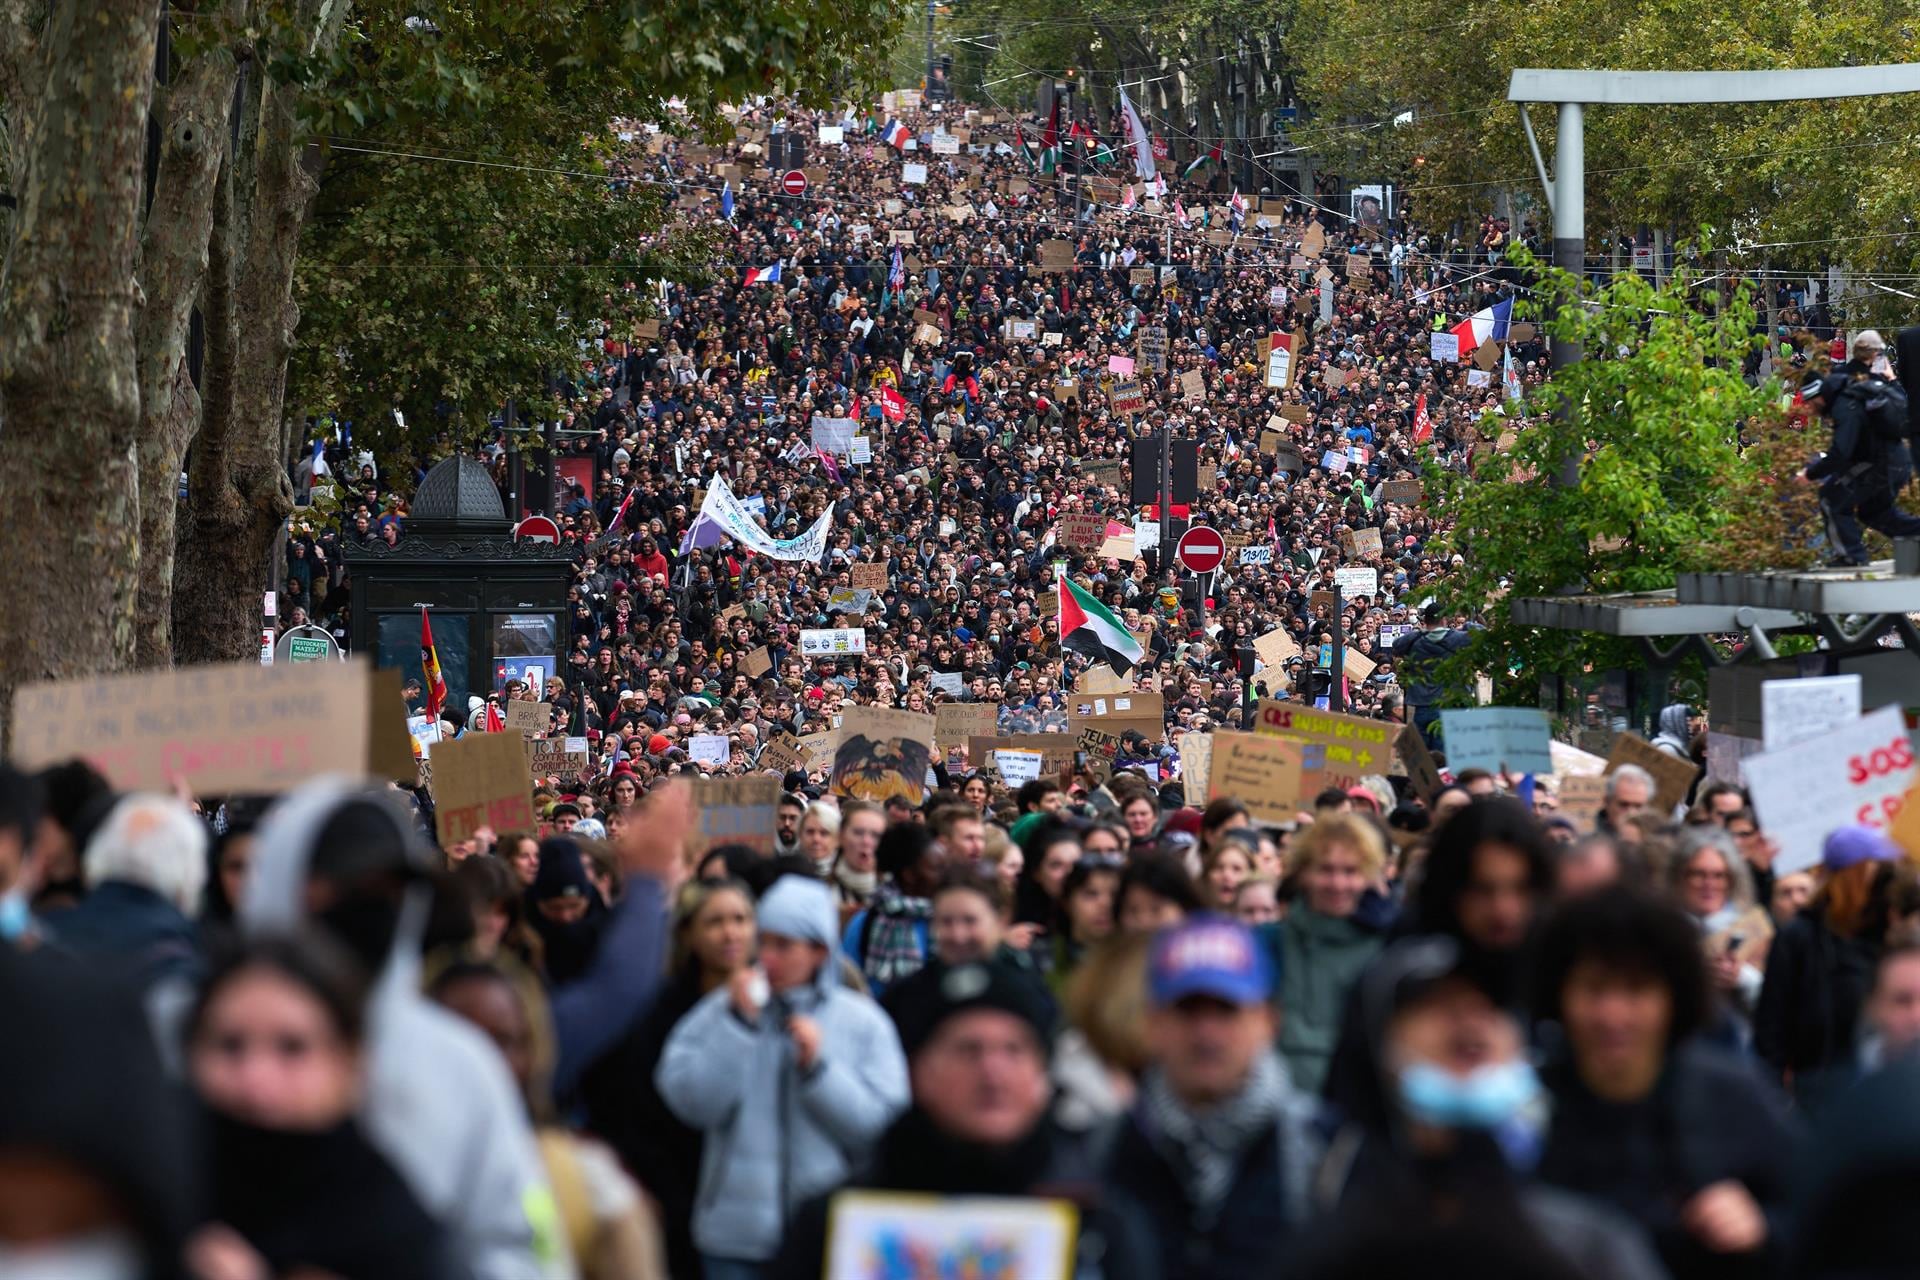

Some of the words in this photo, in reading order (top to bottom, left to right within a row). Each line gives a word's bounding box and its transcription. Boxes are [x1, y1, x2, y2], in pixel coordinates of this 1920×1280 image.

[1113, 397, 1143, 411] FRANCE
[1094, 516, 1103, 525] DE
[1071, 526, 1093, 534] LEUR
[1244, 549, 1270, 561] 1312
[854, 565, 866, 573] MOI
[293, 639, 328, 649] DESTOCKAGE
[518, 711, 538, 722] BRAS
[1264, 707, 1292, 728] CRS
[533, 721, 545, 730] PAS
[1081, 727, 1120, 750] JEUNES
[531, 740, 562, 753] TOUS
[533, 753, 565, 762] CONTRE
[568, 753, 579, 762] LA
[1848, 737, 1915, 784] SOS
[531, 761, 582, 773] CORRUPTION
